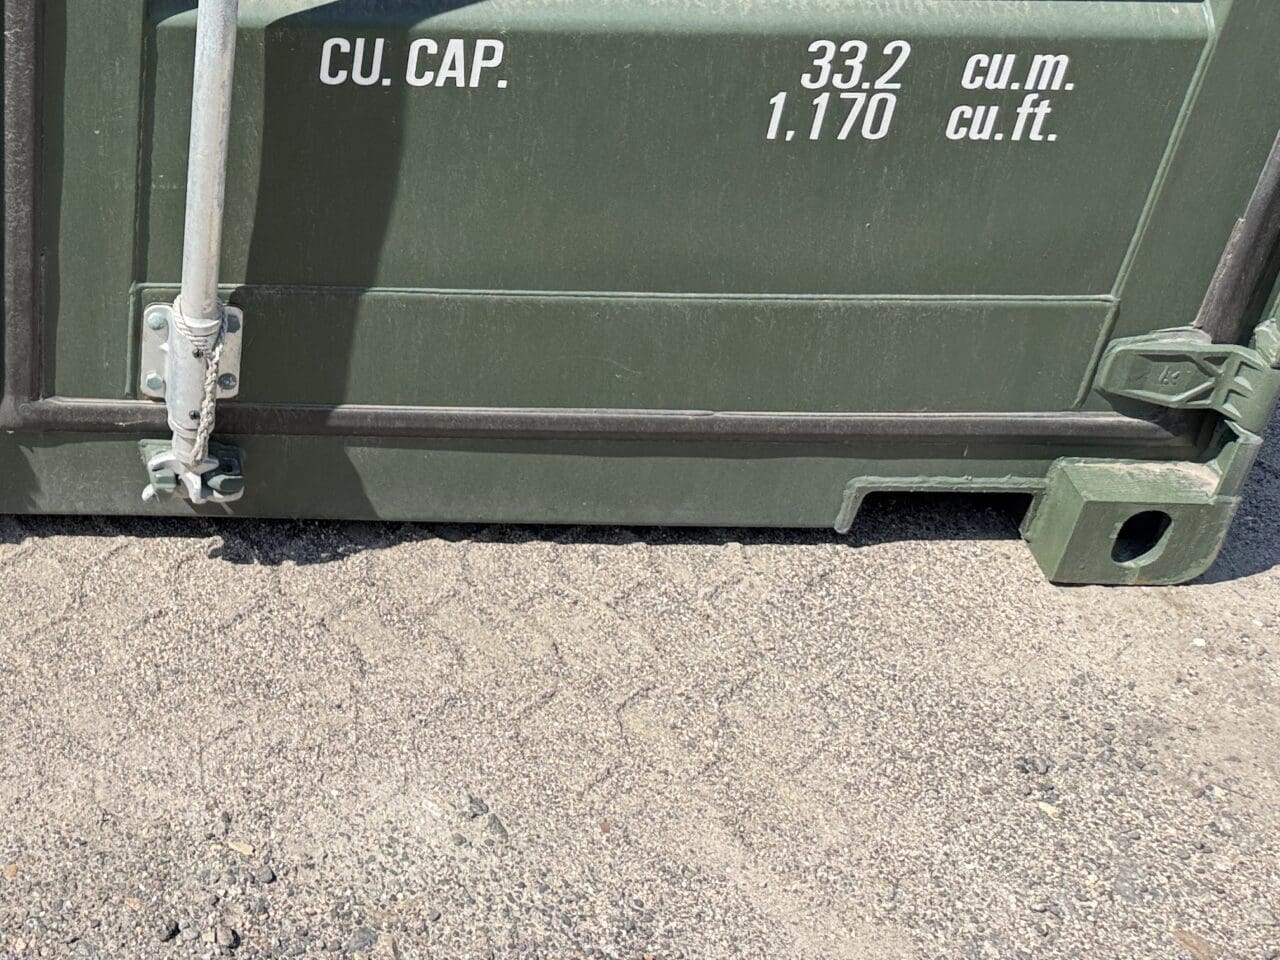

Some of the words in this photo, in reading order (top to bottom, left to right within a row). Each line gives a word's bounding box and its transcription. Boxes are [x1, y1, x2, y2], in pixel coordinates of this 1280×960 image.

[319, 38, 391, 86] CU.
[405, 39, 508, 88] CAP.
[800, 39, 911, 90] 33.2
[961, 53, 1075, 91] cu.m.
[766, 93, 897, 143] 1,170
[945, 94, 1057, 142] cu.ft.
